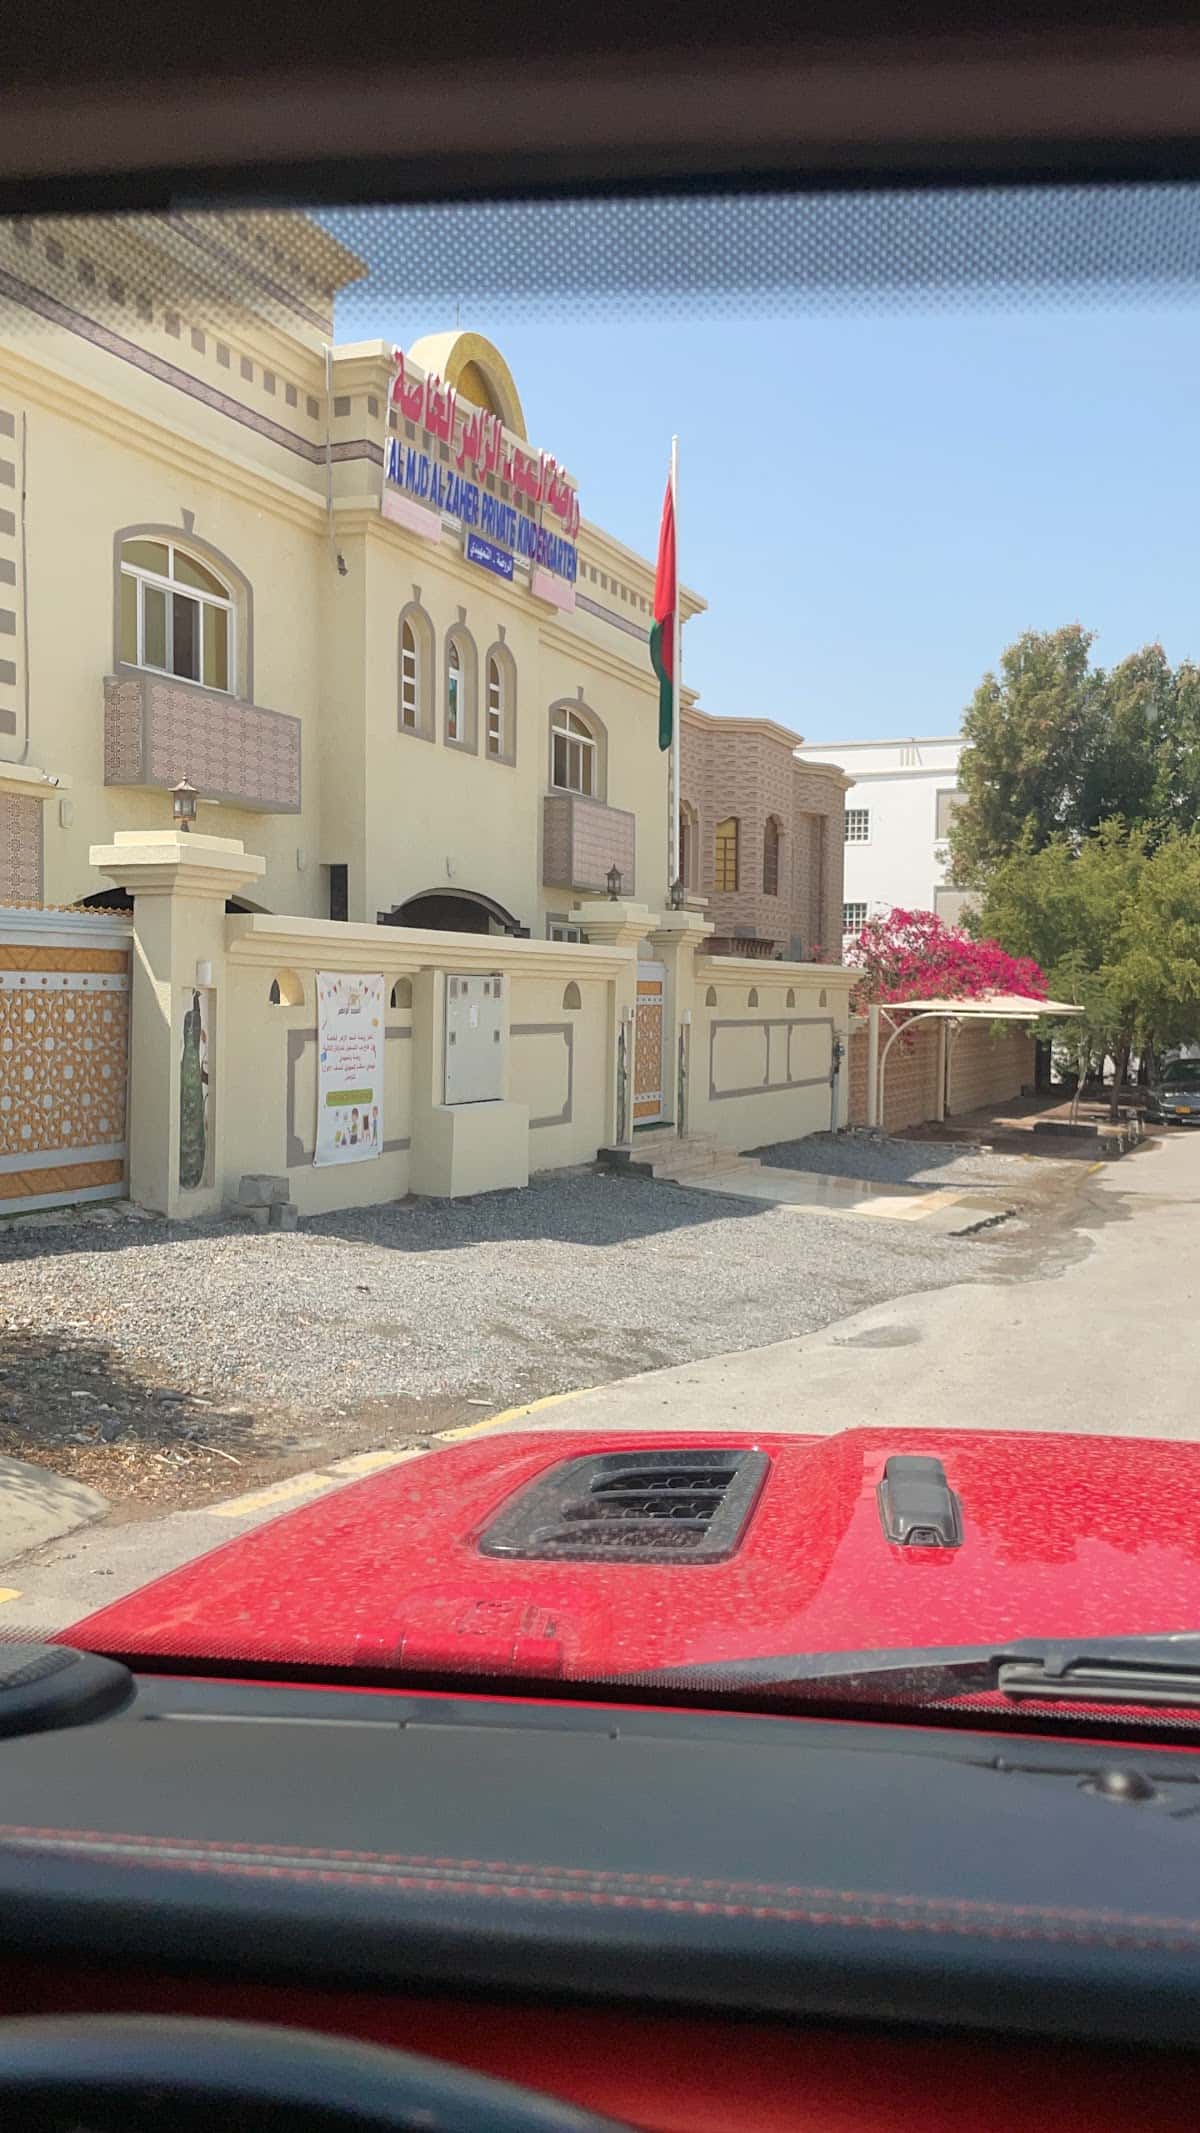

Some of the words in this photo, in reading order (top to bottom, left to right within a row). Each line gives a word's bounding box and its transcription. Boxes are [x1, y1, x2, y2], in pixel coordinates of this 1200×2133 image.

[390, 344, 457, 443] الخاصة
[455, 405, 503, 483] الزاهر
[480, 491, 517, 549] PRIVATE
[517, 513, 577, 583] KINDERGARTEN
[546, 452, 581, 540] روضة
